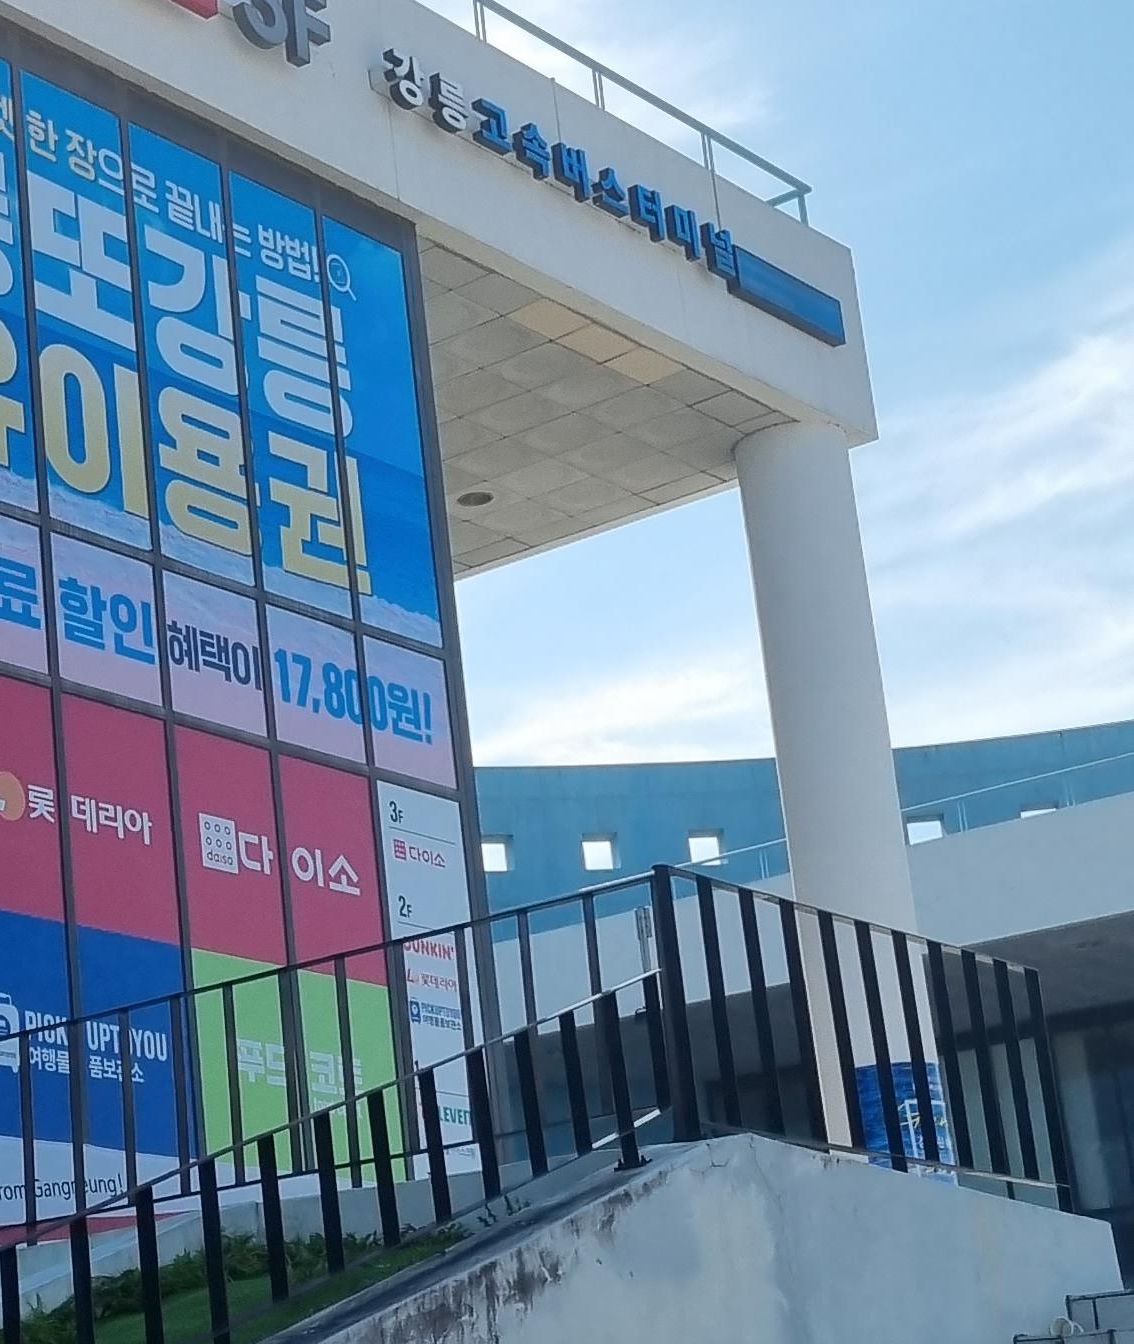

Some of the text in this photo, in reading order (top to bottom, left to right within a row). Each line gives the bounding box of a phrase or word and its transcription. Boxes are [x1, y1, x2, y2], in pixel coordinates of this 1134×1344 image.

[26, 109, 59, 163] 한
[66, 128, 159, 214] 장으로
[165, 179, 252, 258] 끝내는
[257, 223, 321, 284] 방법!
[58, 576, 155, 665] 할인
[167, 619, 263, 692] 혜택이
[273, 648, 433, 745] 17,800원!
[27, 784, 153, 846] 롯데리아
[389, 800, 404, 825] 3F
[238, 831, 361, 896] 다이소
[408, 845, 446, 868] 다이소
[398, 895, 413, 918] 2F
